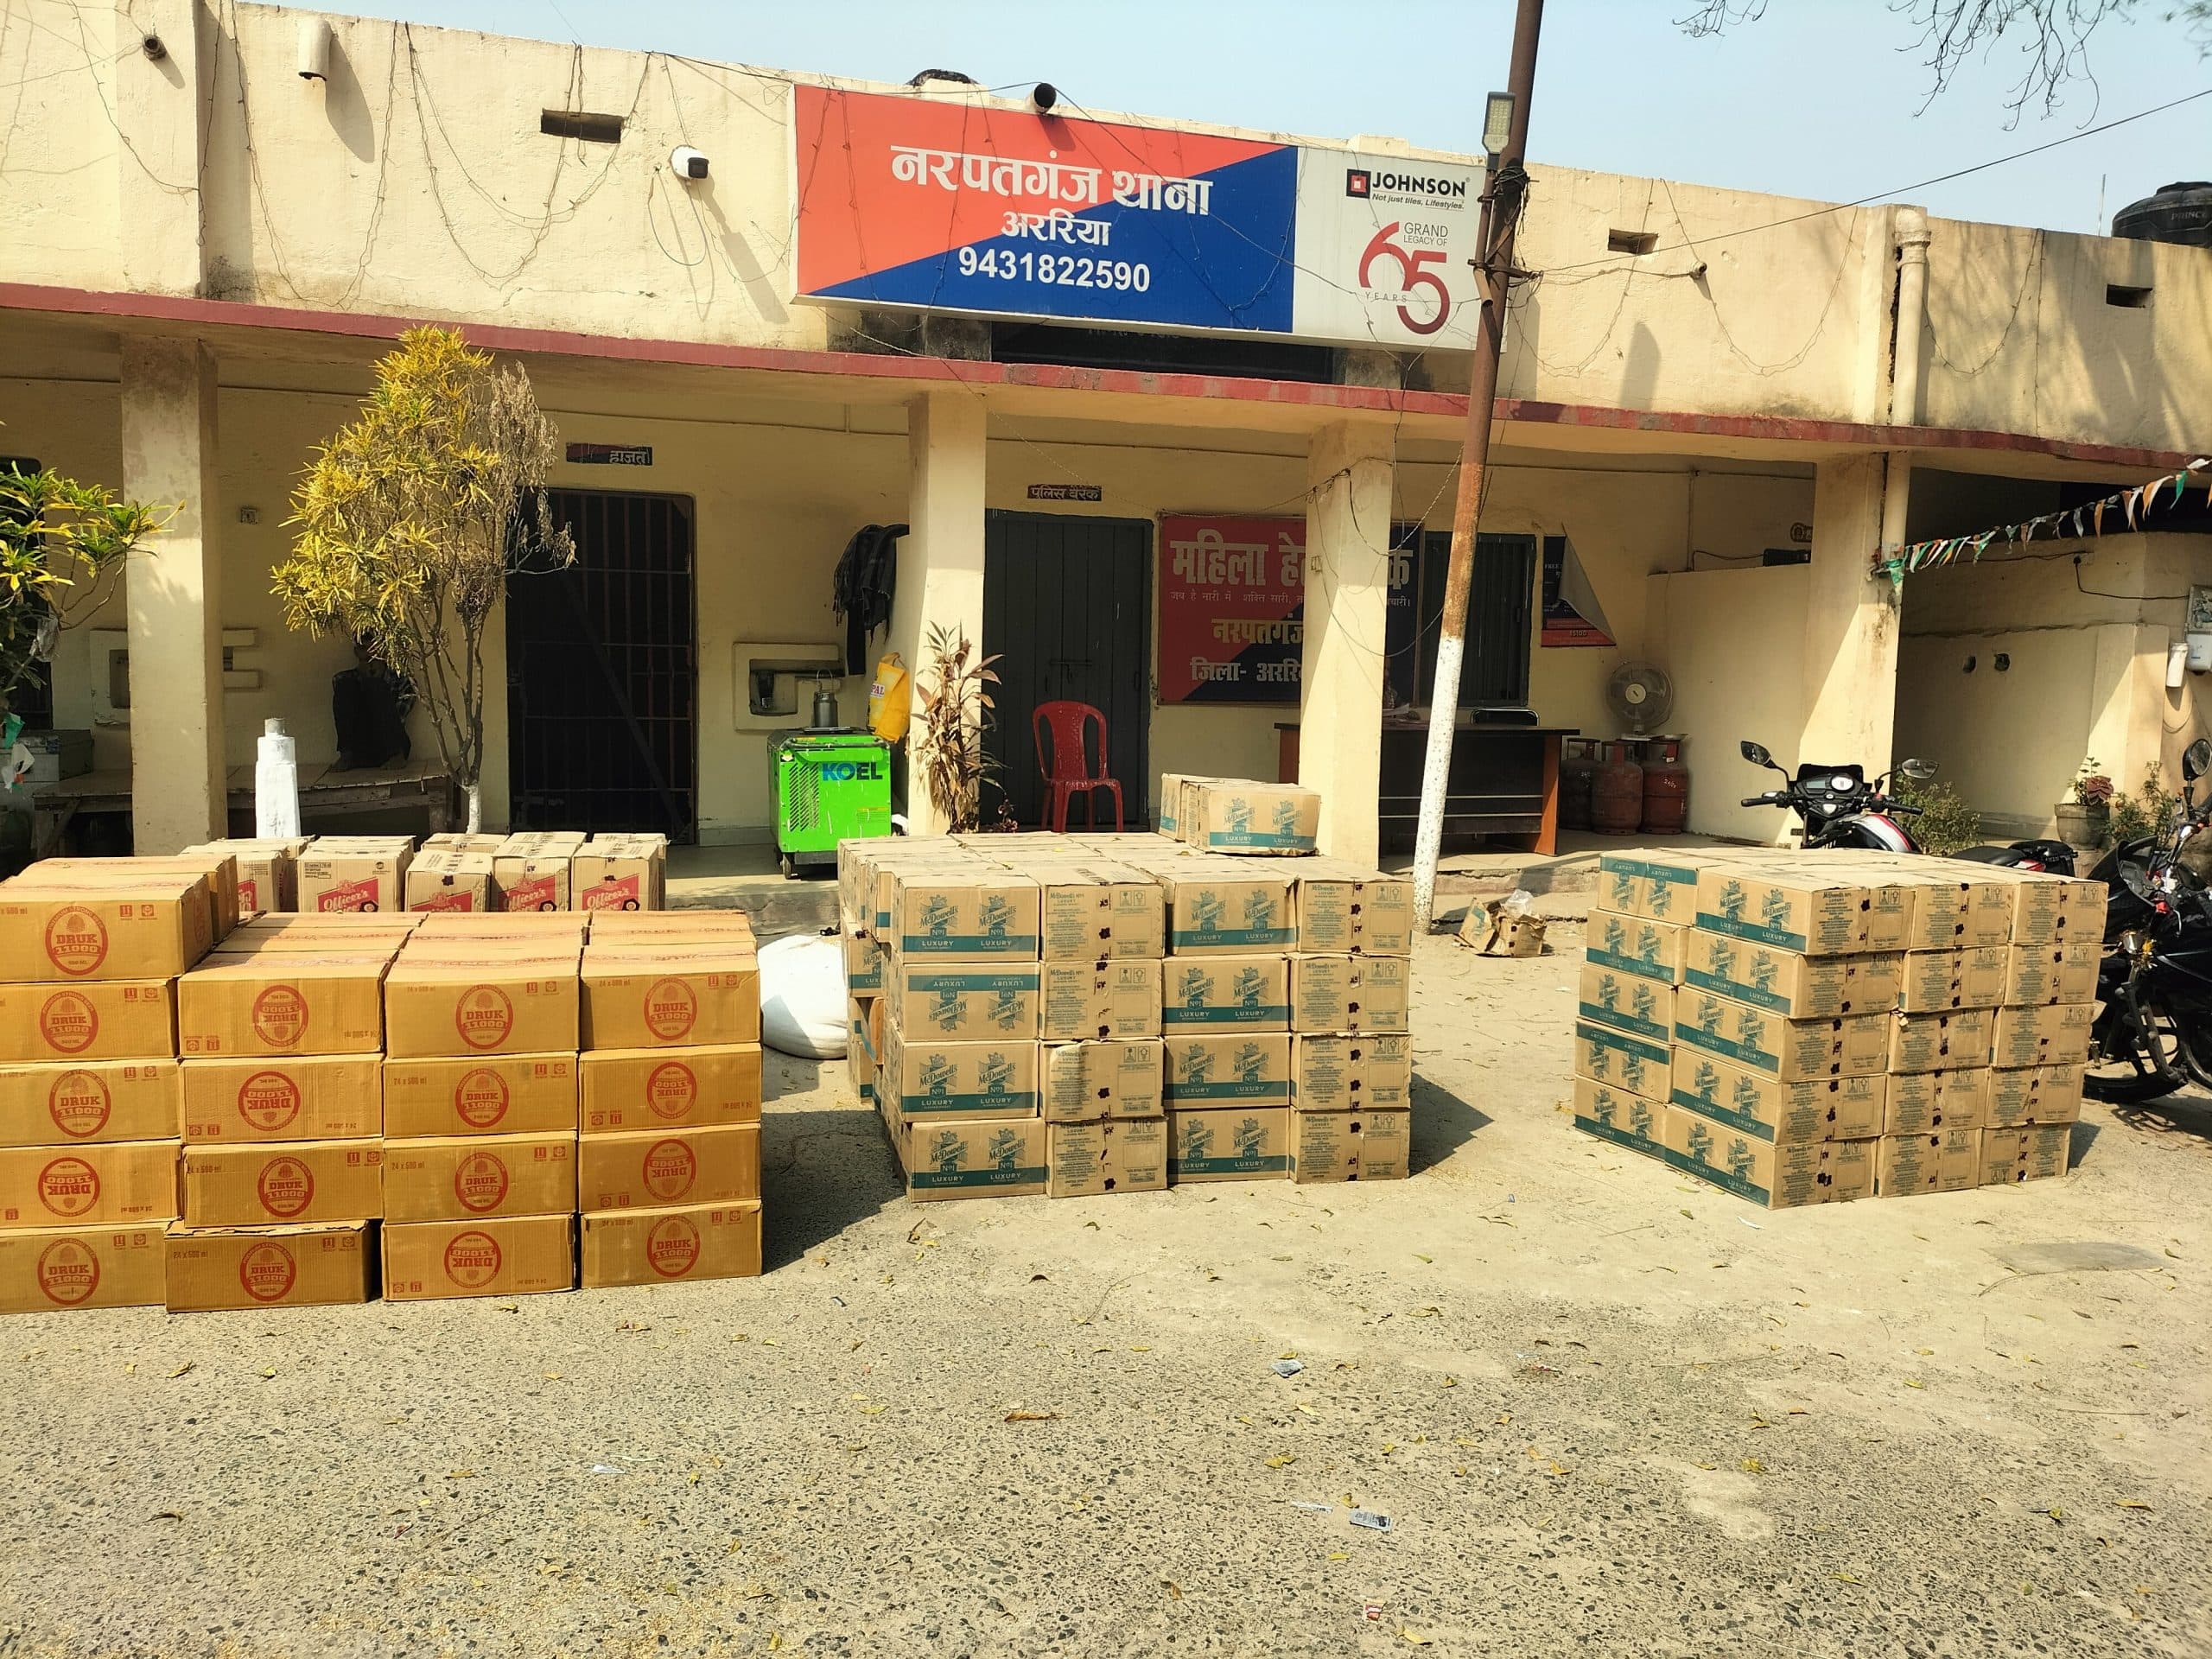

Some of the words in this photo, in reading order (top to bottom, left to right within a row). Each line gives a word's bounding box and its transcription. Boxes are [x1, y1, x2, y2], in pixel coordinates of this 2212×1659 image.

[891, 145, 1102, 204] नरपतगंज
[1111, 170, 1213, 215] थाना
[1373, 172, 1465, 197] JOHNSON
[1405, 197, 1423, 206] tiles,
[1426, 199, 1464, 210] Lifestyles.
[1001, 208, 1111, 246] अररिया
[1404, 222, 1448, 237] GRAND
[1404, 236, 1434, 245] LEGACY
[1437, 238, 1447, 246] OF
[959, 248, 1150, 292] 9431822590
[1359, 221, 1450, 334] 65
[1365, 292, 1407, 302] YEARS
[610, 450, 647, 465] हाजत
[1171, 529, 1268, 585] महिला
[1279, 532, 1306, 586] हे
[1171, 592, 1185, 601] जब
[1202, 592, 1219, 601] नारी
[1256, 658, 1302, 682] अररि
[823, 762, 883, 781] KOEL
[56, 933, 98, 944] DRUK
[1762, 931, 1788, 942] LUXURY
[56, 944, 98, 954] 11000
[1749, 991, 1773, 1003] LUXURY
[653, 1002, 688, 1012] DRUK
[467, 1010, 504, 1020] DRUK
[51, 1016, 87, 1025] DRUK
[465, 1020, 505, 1029] 11000
[60, 1096, 101, 1107] DRUK
[466, 1092, 498, 1101] DRUK
[60, 1108, 102, 1116] 11000
[466, 1176, 498, 1185] DRUK
[48, 1185, 91, 1195] DRUK
[656, 1240, 692, 1249] DRUK
[48, 1265, 90, 1274] DRUK
[251, 1266, 284, 1274] DRUK
[48, 1275, 91, 1284] 11000
